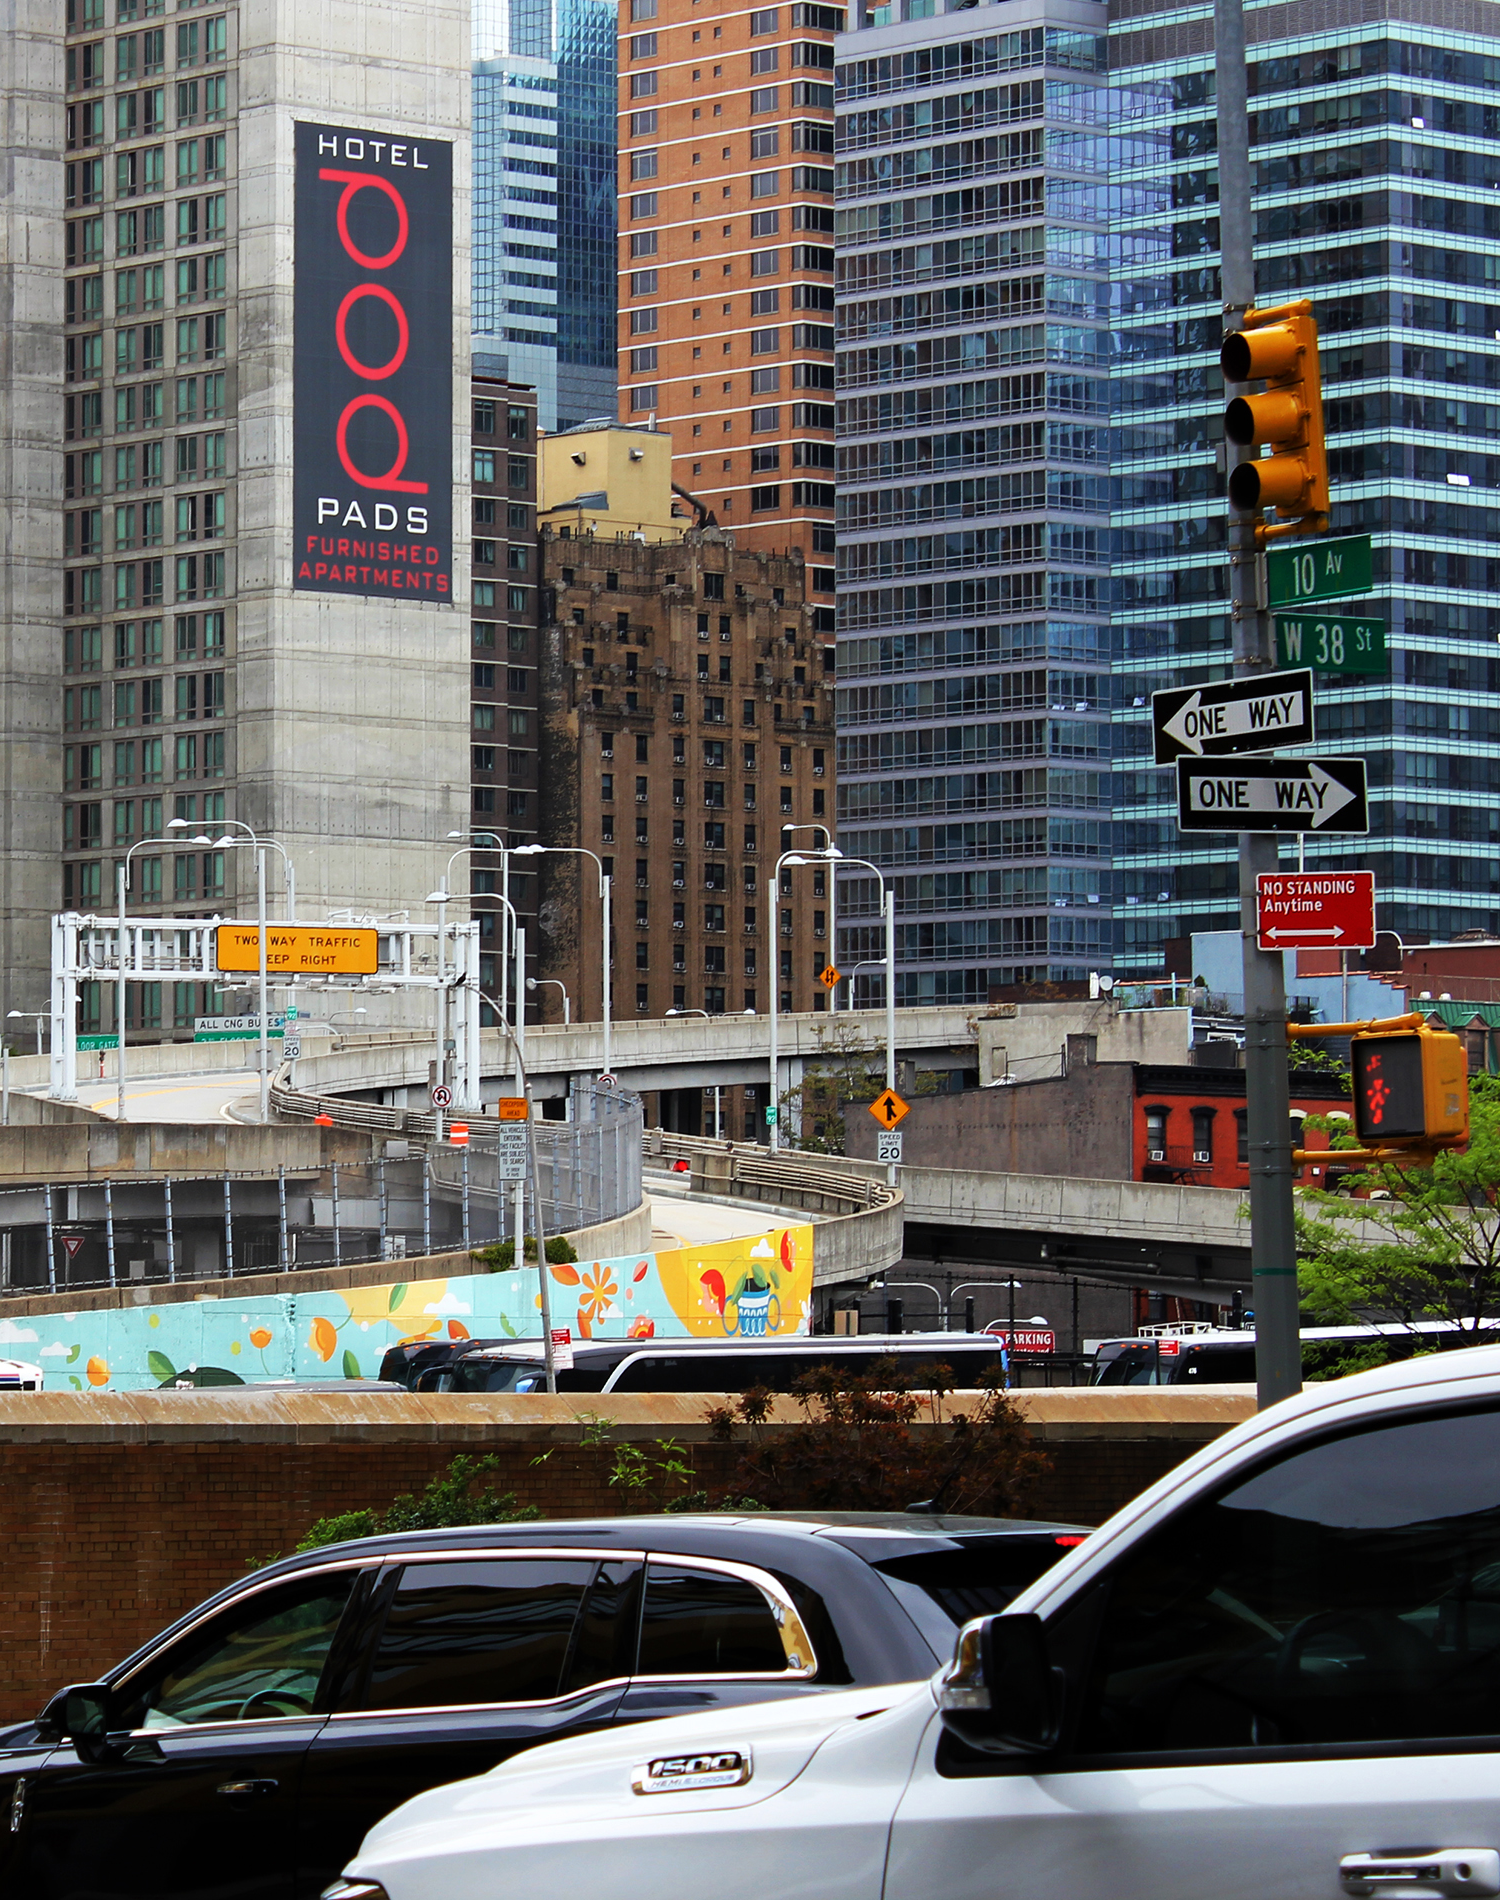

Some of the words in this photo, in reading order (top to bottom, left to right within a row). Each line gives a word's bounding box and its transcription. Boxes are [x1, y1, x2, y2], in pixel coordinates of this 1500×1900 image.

[318, 133, 429, 169] HOTEL
[317, 496, 429, 535] PADS
[306, 535, 439, 566] FURNISHED
[298, 560, 449, 593] APARTMENTS
[1291, 553, 1316, 597] 10
[1325, 551, 1343, 576] Av
[1283, 622, 1303, 662] W
[1314, 623, 1345, 666] 38
[1355, 626, 1372, 653] St
[1184, 706, 1227, 739] ONE
[1248, 694, 1295, 729] WAY
[1198, 779, 1250, 809] ONE
[1274, 780, 1330, 810] WAY
[1263, 881, 1282, 895] NO
[1287, 879, 1355, 895] STANDING
[1264, 898, 1323, 916] Anytime
[234, 935, 259, 946] TWO
[270, 936, 297, 946] WAY
[308, 937, 361, 948] TRAFFIC
[267, 954, 289, 965] EEP
[301, 955, 337, 966] RIGHT
[199, 1020, 218, 1029] ALL
[223, 1019, 243, 1029] CNG
[248, 1018, 280, 1028] BUES
[77, 1041, 95, 1051] LOOR
[284, 1046, 300, 1056] 20
[500, 1100, 526, 1108] CHECKPOINT
[879, 1147, 900, 1159] 20
[1005, 1333, 1051, 1345] PARKING
[652, 1754, 736, 1776] 1500
[651, 1779, 682, 1788] HEMI
